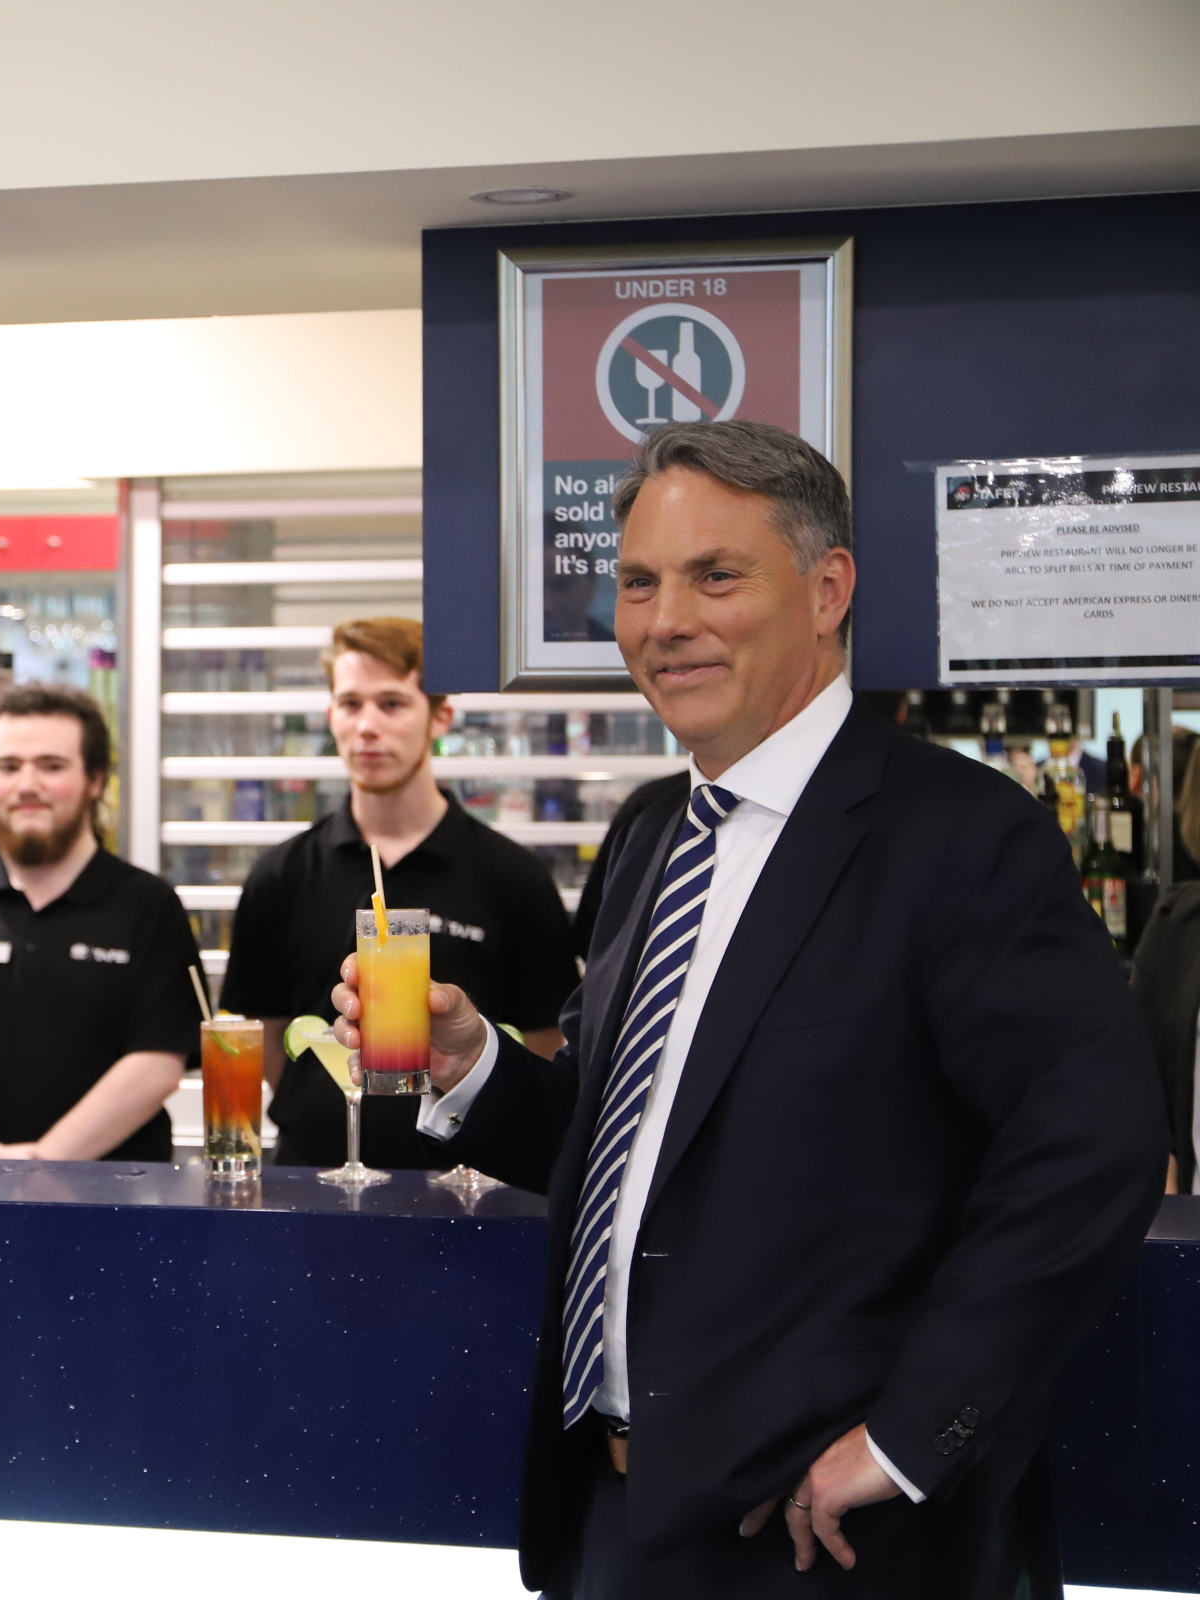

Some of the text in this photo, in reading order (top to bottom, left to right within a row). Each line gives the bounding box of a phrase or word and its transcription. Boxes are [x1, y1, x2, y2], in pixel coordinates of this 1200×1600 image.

[615, 277, 727, 299] UNDER 18
[554, 474, 618, 495] No al
[1102, 483, 1157, 496] PIEW
[554, 501, 604, 522] sold
[1057, 524, 1139, 534] PLEASE BE ADVISED
[554, 530, 621, 552] anyo
[1001, 544, 1198, 558] PREVIEW RESTAURANT WILL NO LONGER BE
[554, 554, 619, 578] It's ag
[1029, 565, 1041, 574] TO
[1044, 564, 1067, 573] SPLIT
[1069, 563, 1092, 573] BILLS
[1095, 563, 1106, 572] AT
[1109, 562, 1131, 571] TIME
[1134, 562, 1146, 571] OF
[1149, 561, 1193, 570] PAYMENT
[971, 599, 986, 609] WE
[989, 599, 1002, 608] DO
[1004, 599, 1023, 608] NOT
[1026, 598, 1060, 607] ACCEPT
[1062, 597, 1111, 606] AMERICAN
[1114, 595, 1152, 605] EXPRESS
[1154, 595, 1167, 603] OR
[1084, 610, 1114, 619] CARDS
